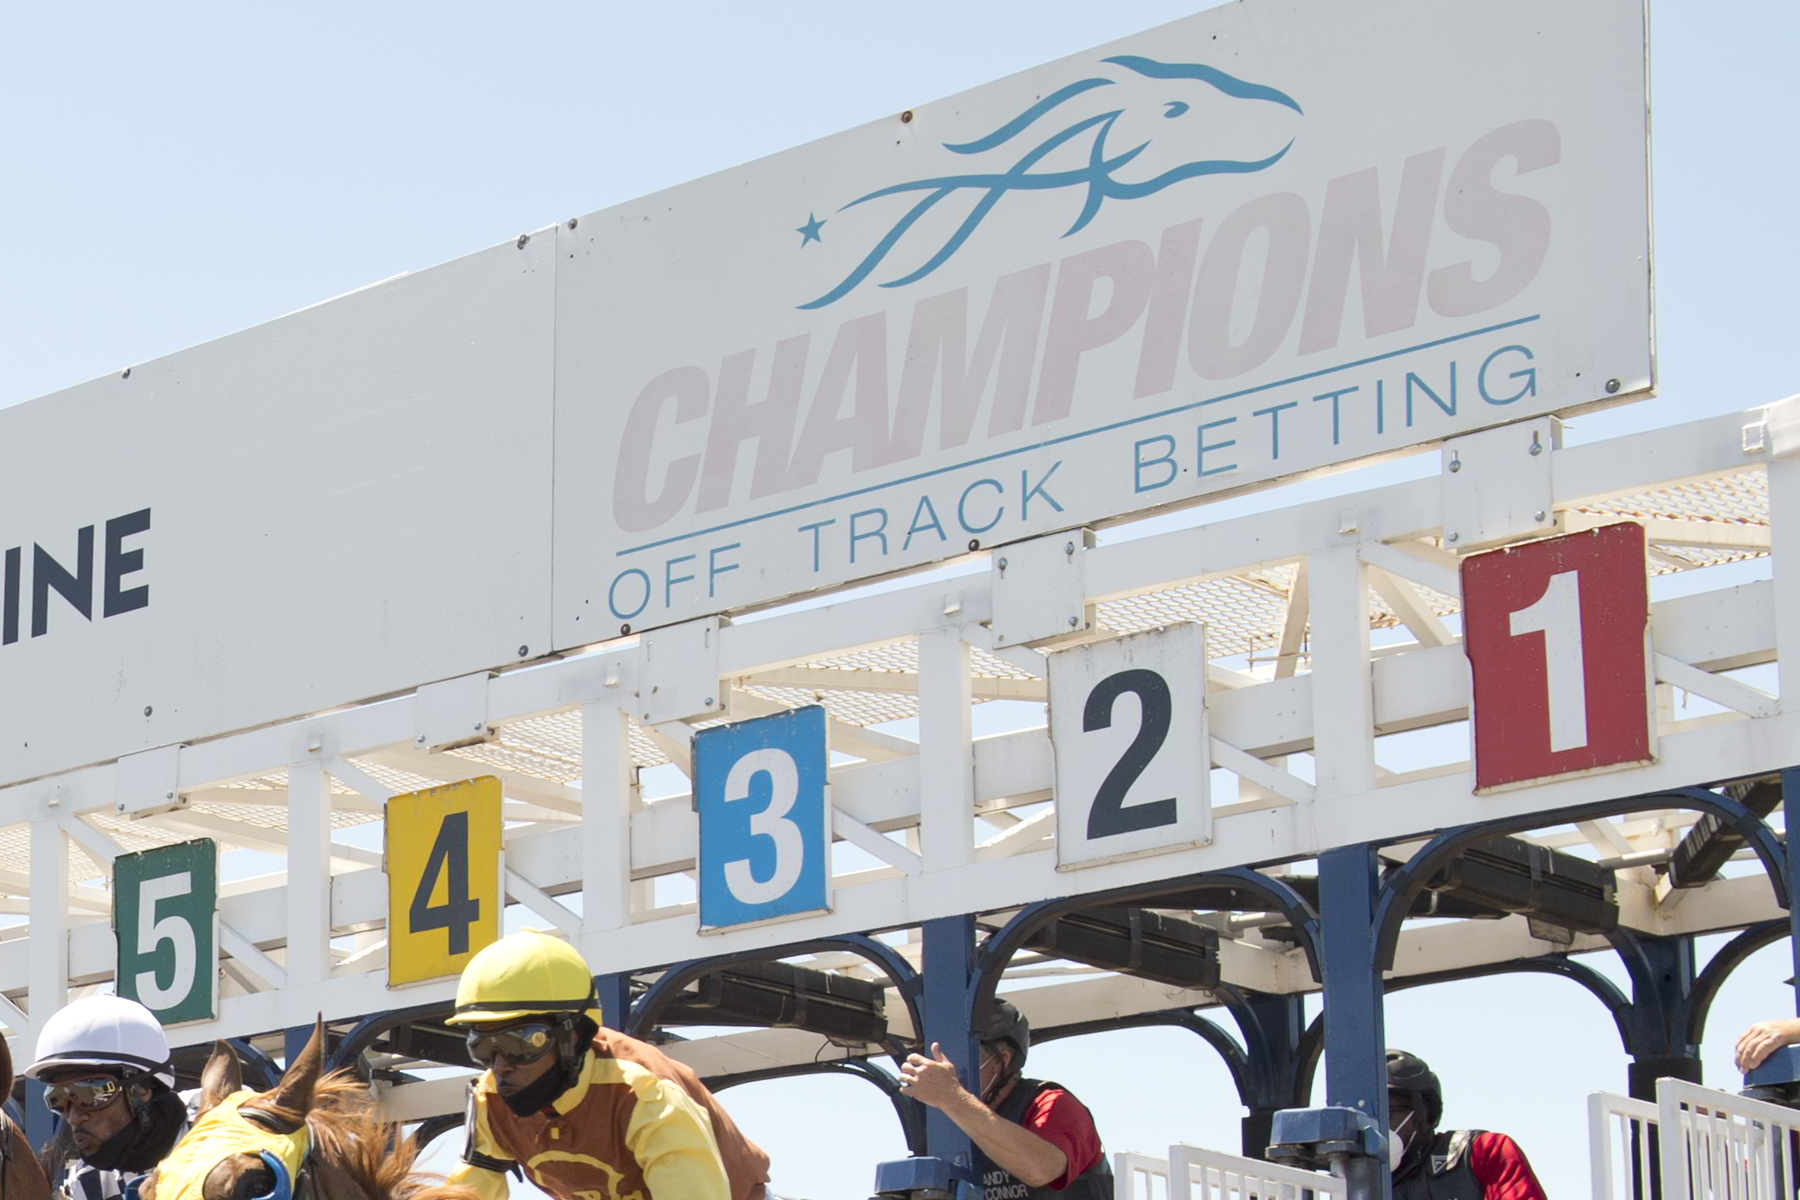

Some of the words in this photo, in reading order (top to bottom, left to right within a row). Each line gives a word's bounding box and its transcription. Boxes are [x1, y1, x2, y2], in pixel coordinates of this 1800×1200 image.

[611, 118, 1562, 533] CHAMPIONS
[607, 541, 742, 621] OFF
[797, 460, 1065, 573] TRACK
[1133, 344, 1538, 495] BETTING
[1509, 569, 1588, 753] 1
[723, 747, 804, 906] 3
[1082, 668, 1178, 841] 2
[134, 871, 198, 1011] 5
[408, 811, 481, 956] 4
